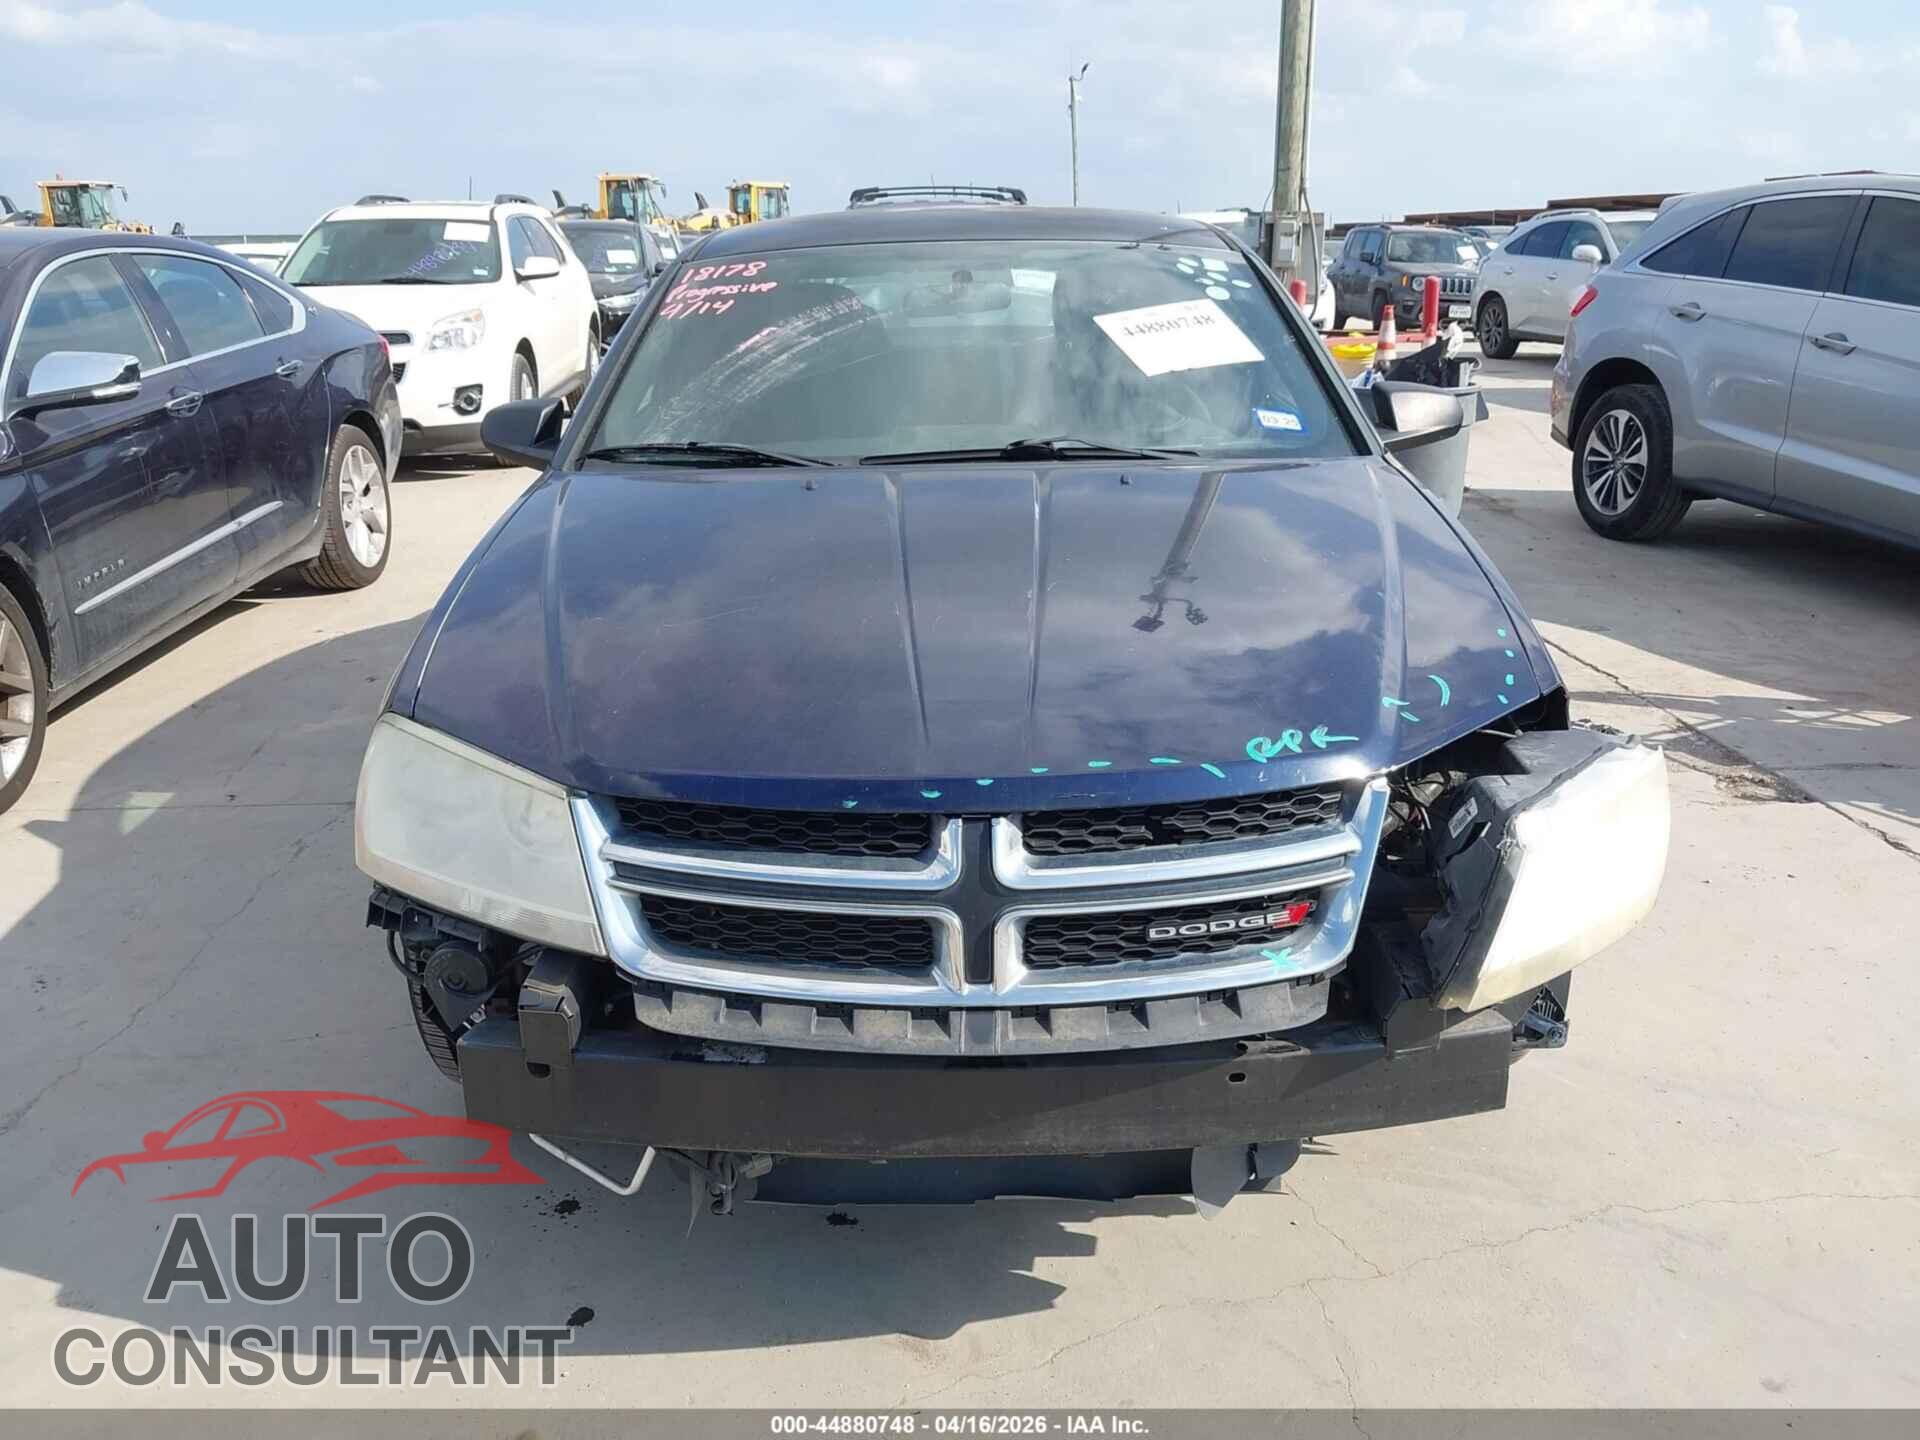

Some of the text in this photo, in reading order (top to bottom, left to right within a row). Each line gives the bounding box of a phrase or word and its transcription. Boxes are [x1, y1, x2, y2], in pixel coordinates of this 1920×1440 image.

[681, 261, 767, 283] 18178
[660, 299, 735, 320] 4/14
[1149, 910, 1291, 939] DODGE
